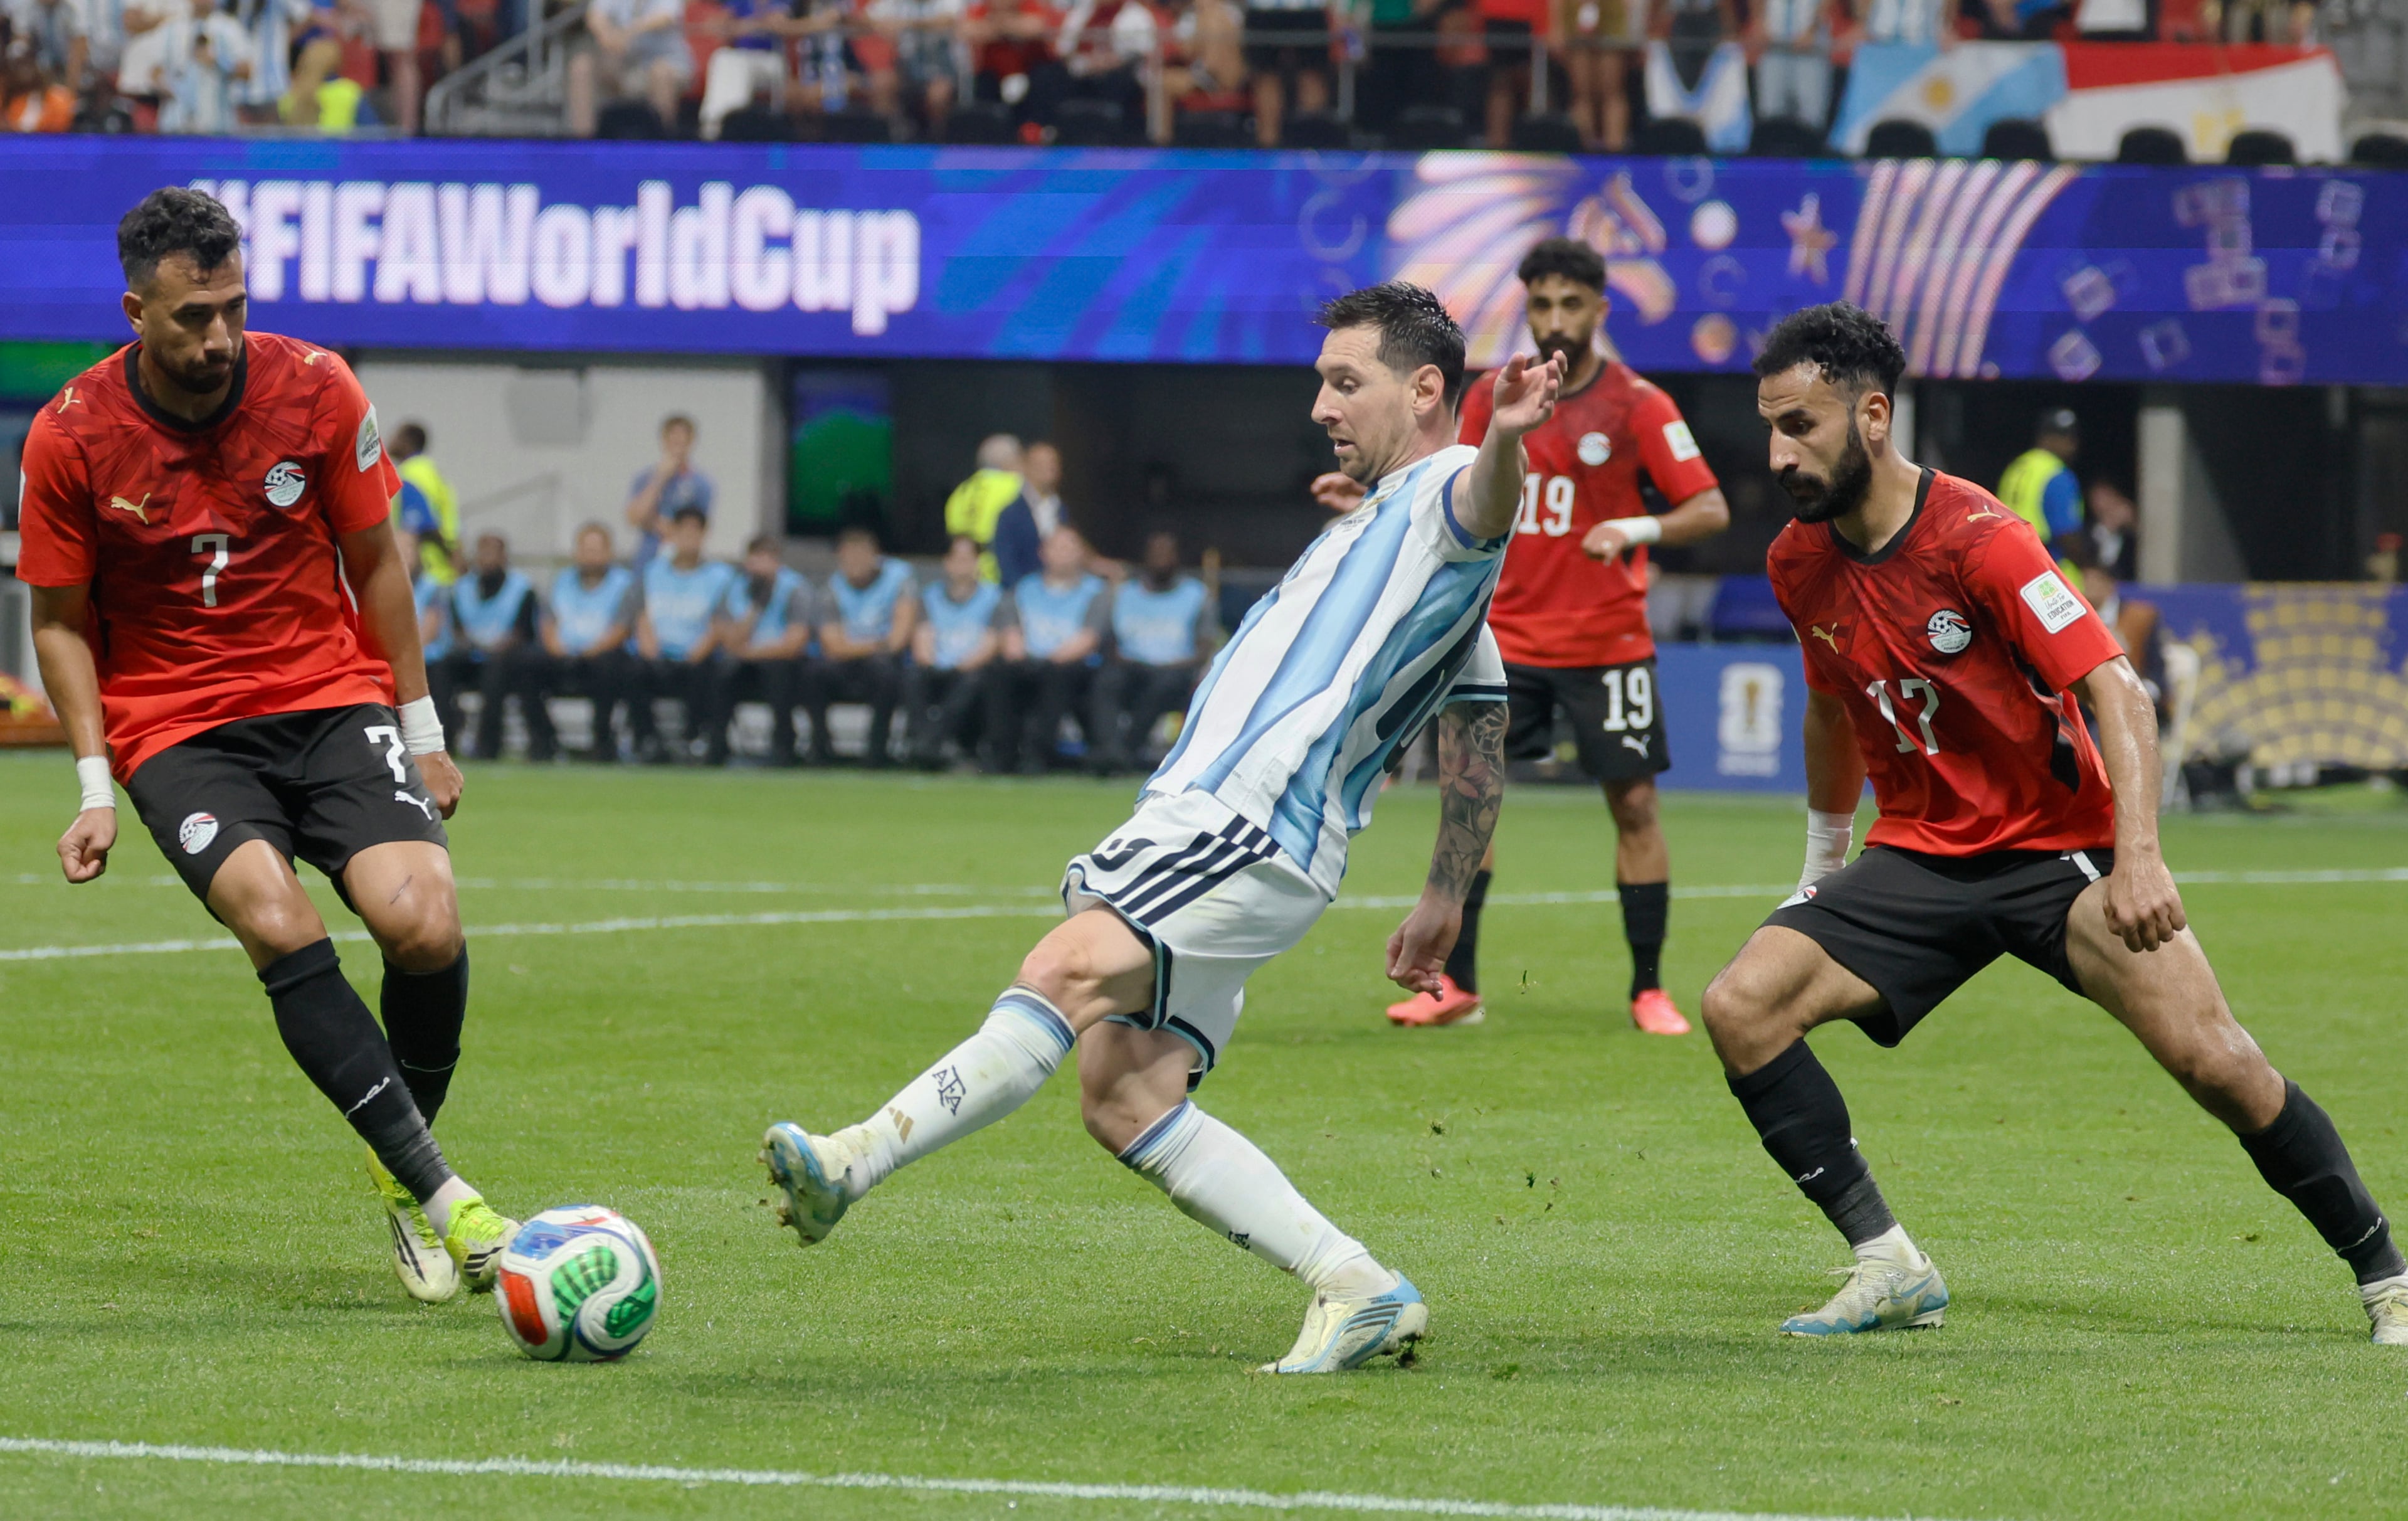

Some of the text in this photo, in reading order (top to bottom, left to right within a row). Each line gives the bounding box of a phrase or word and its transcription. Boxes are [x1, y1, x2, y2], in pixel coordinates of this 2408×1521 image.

[1518, 472, 1575, 537] 19
[191, 533, 230, 608] 7
[2047, 600, 2074, 620] EDUCATION
[1601, 666, 1654, 731] 19
[1866, 679, 1940, 755] 17
[364, 726, 406, 783] 7
